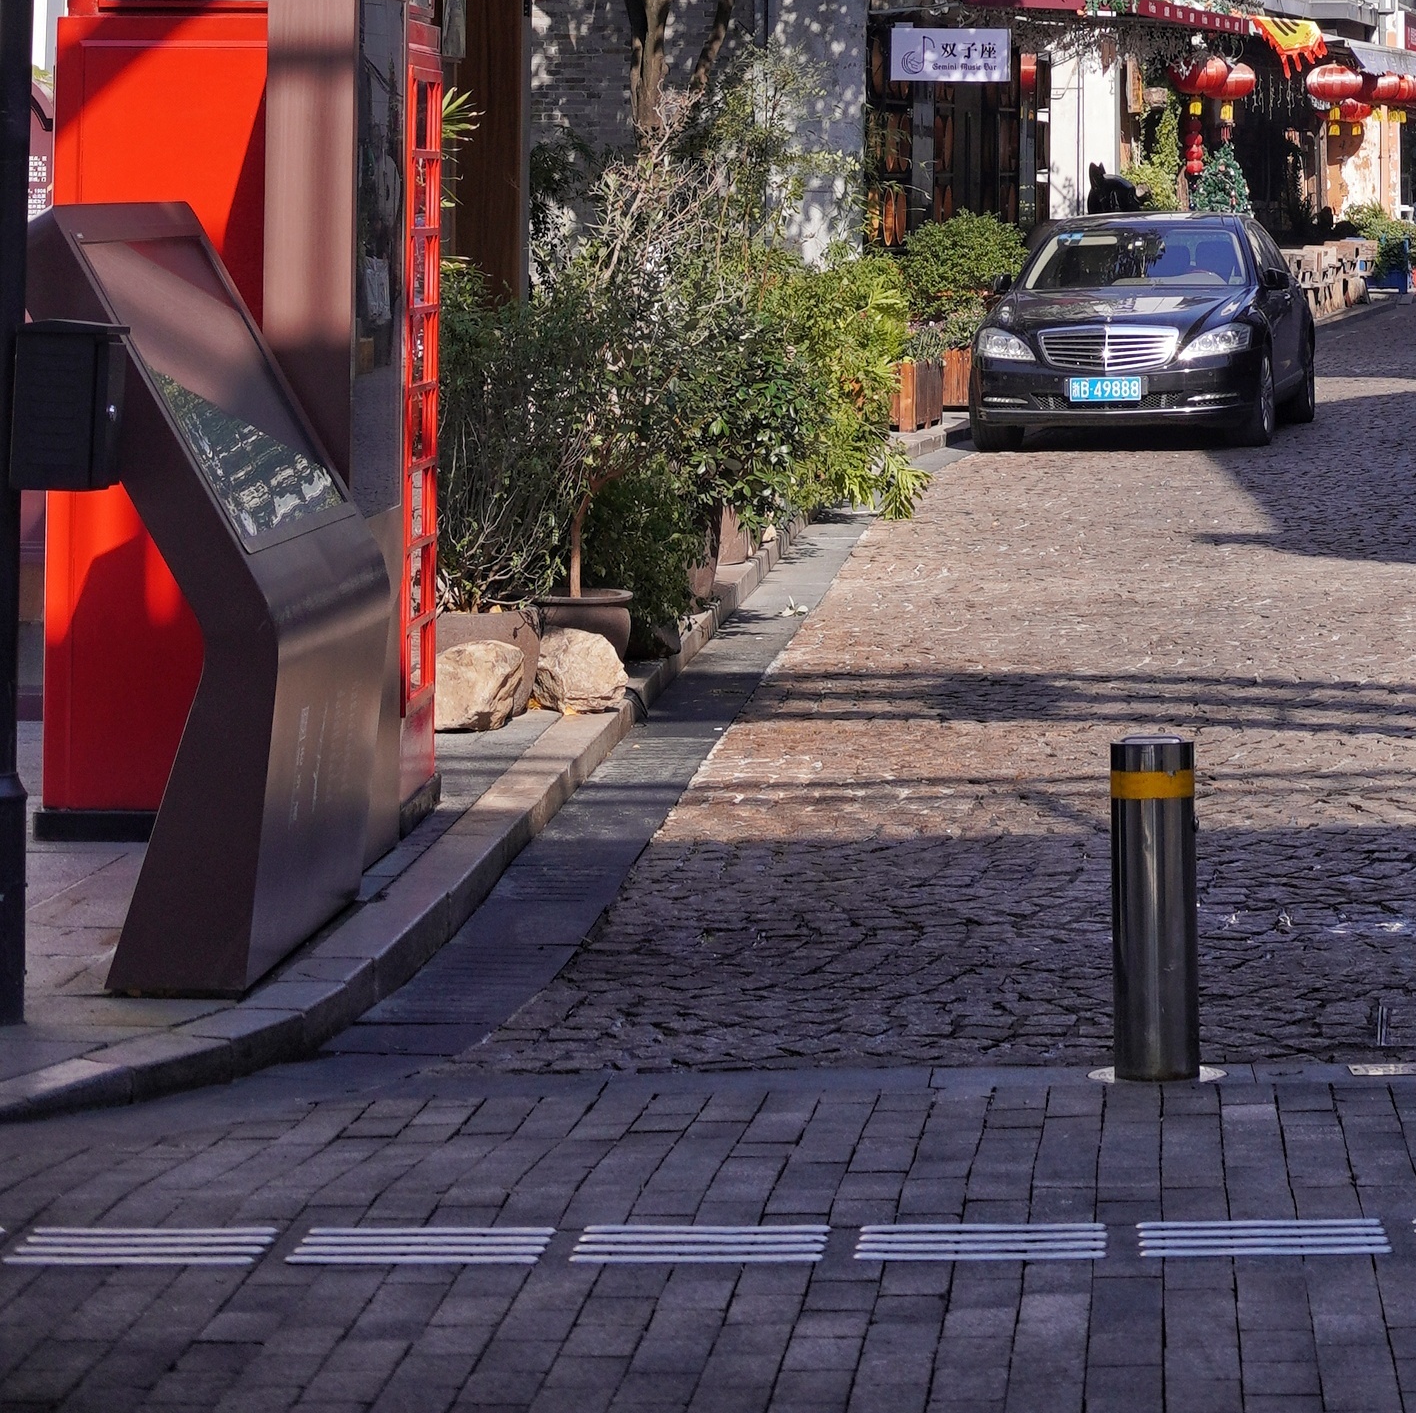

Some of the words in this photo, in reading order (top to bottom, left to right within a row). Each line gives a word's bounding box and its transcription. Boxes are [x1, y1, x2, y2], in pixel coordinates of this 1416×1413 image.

[940, 41, 997, 59] 双子座
[932, 62, 957, 71] Gemini
[960, 62, 981, 71] Music
